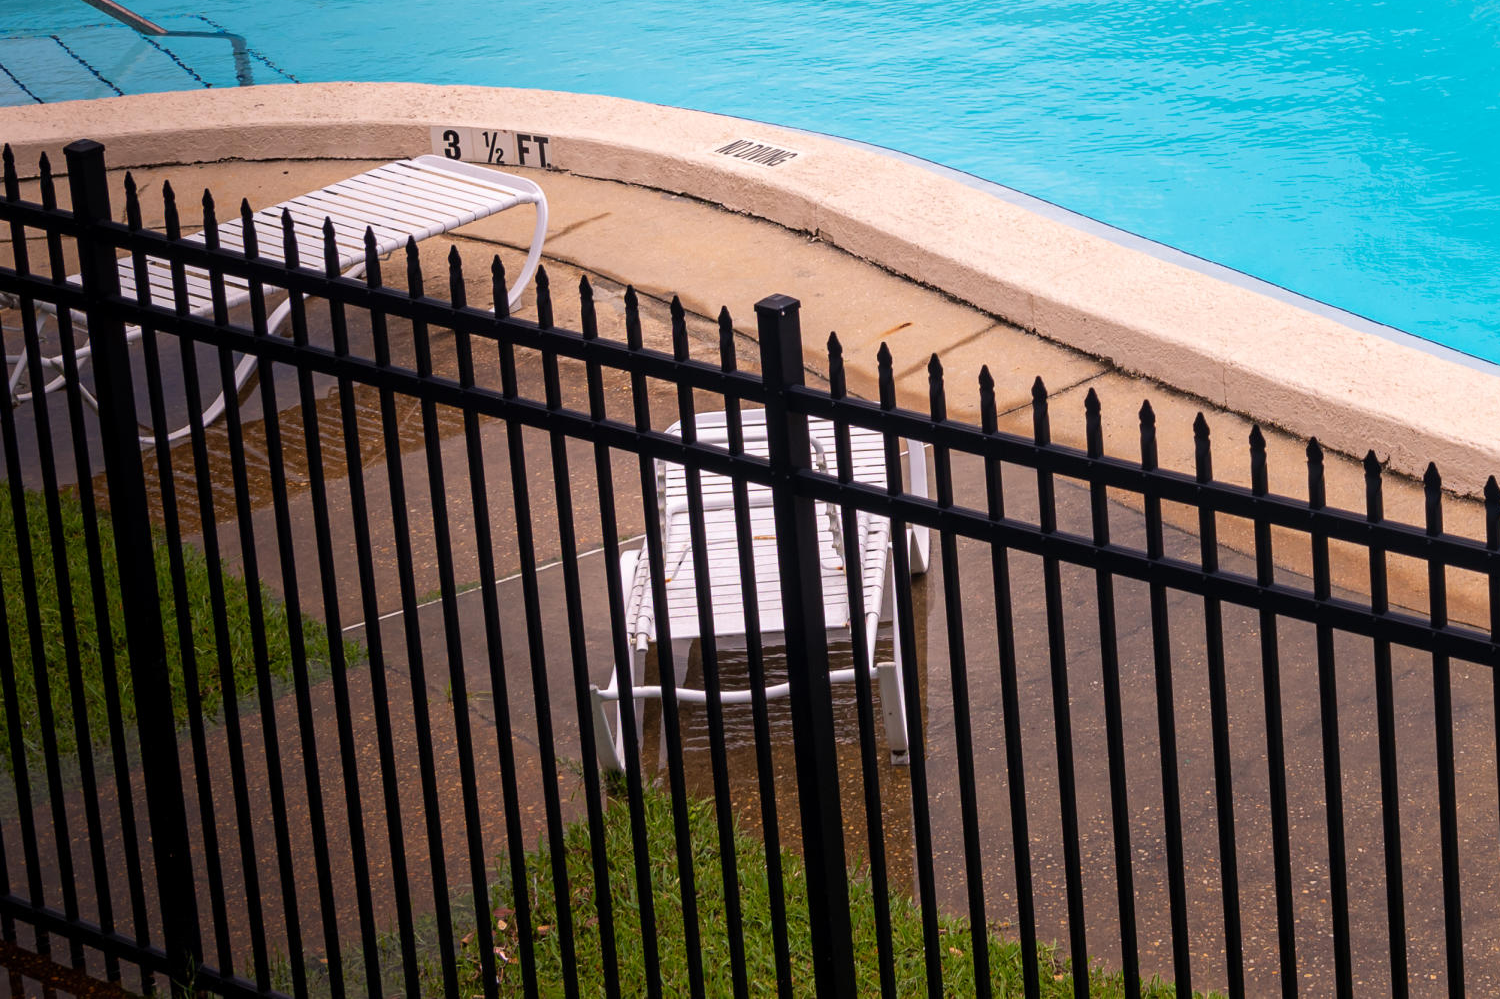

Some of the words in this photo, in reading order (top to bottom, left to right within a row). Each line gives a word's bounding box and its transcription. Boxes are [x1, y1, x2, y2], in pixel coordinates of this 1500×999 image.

[443, 129, 462, 161] 3
[516, 133, 551, 169] FT.
[714, 139, 755, 155] NO
[732, 144, 799, 167] DIVING
